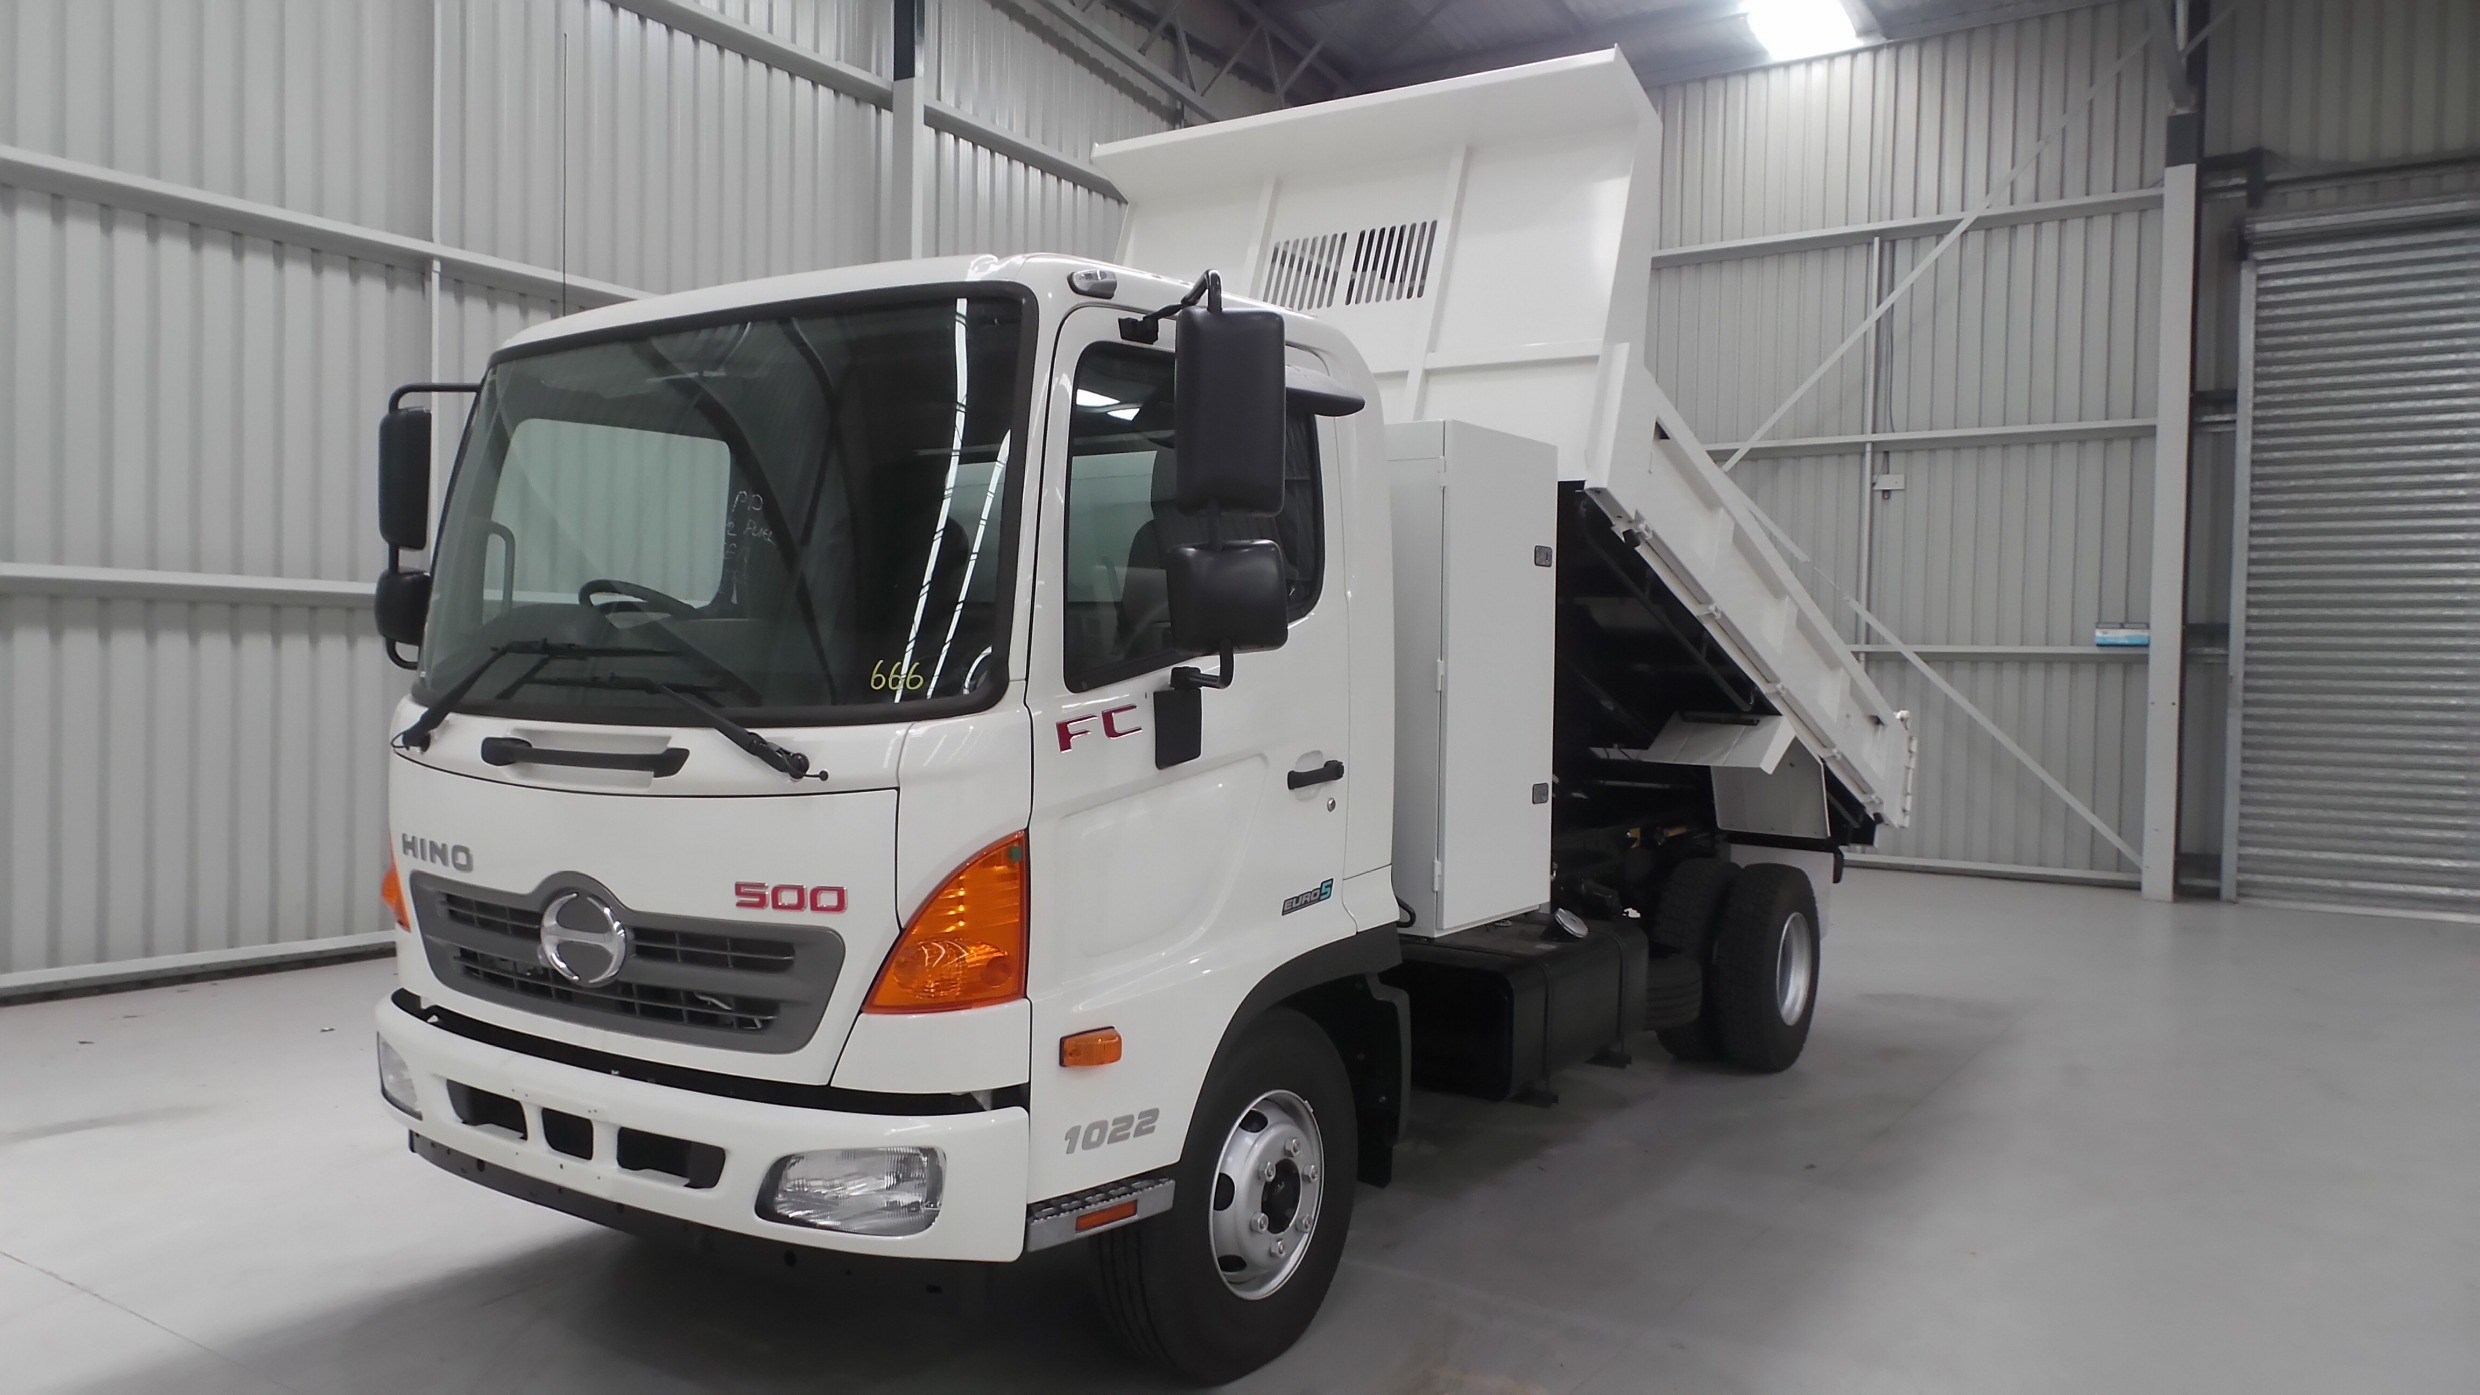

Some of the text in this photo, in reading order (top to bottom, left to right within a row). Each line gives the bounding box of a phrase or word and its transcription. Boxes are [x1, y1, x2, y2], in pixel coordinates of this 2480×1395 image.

[869, 659, 925, 691] 666
[1055, 703, 1143, 754] FC
[402, 832, 474, 873] HINO
[734, 880, 849, 914] 500
[1064, 1107, 1160, 1155] 1022
